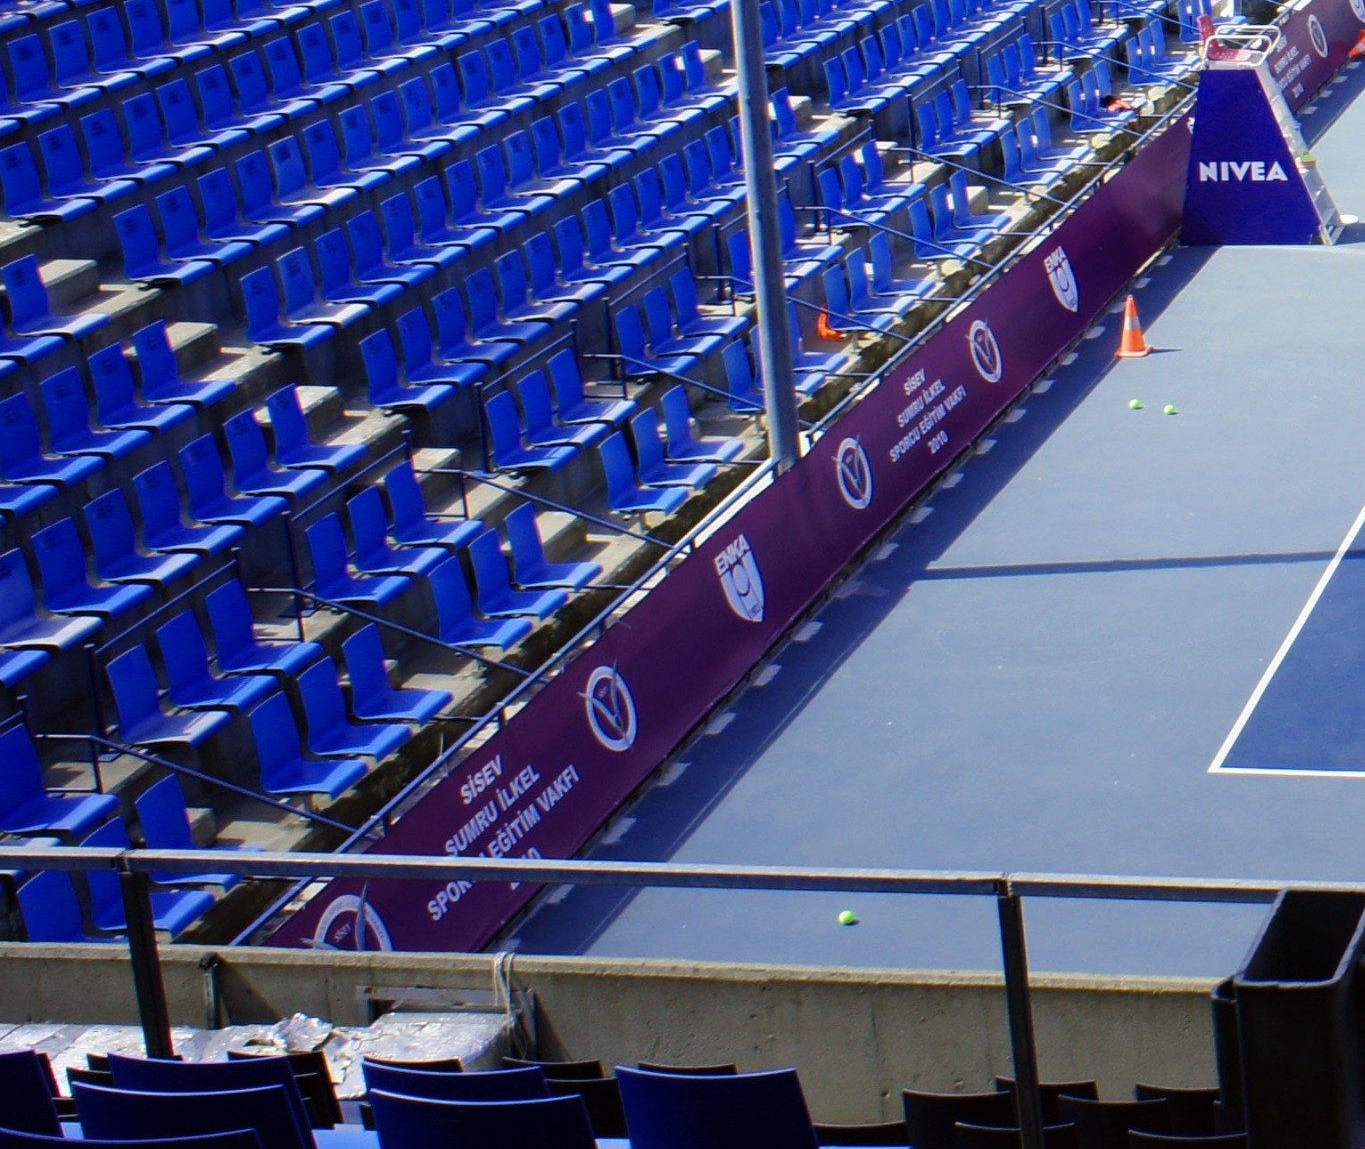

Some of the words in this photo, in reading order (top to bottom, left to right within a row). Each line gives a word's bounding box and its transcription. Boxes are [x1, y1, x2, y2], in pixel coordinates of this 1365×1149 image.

[1199, 161, 1289, 182] NIVEA
[1043, 245, 1067, 274] ENKA
[928, 430, 948, 454] 2010
[714, 533, 751, 576] ENKA
[460, 754, 505, 805] SİSEV
[445, 800, 498, 858] SUMRU
[496, 764, 541, 812] İLKEL
[487, 803, 541, 858] EĞİTİM
[536, 764, 580, 812] VAKFI
